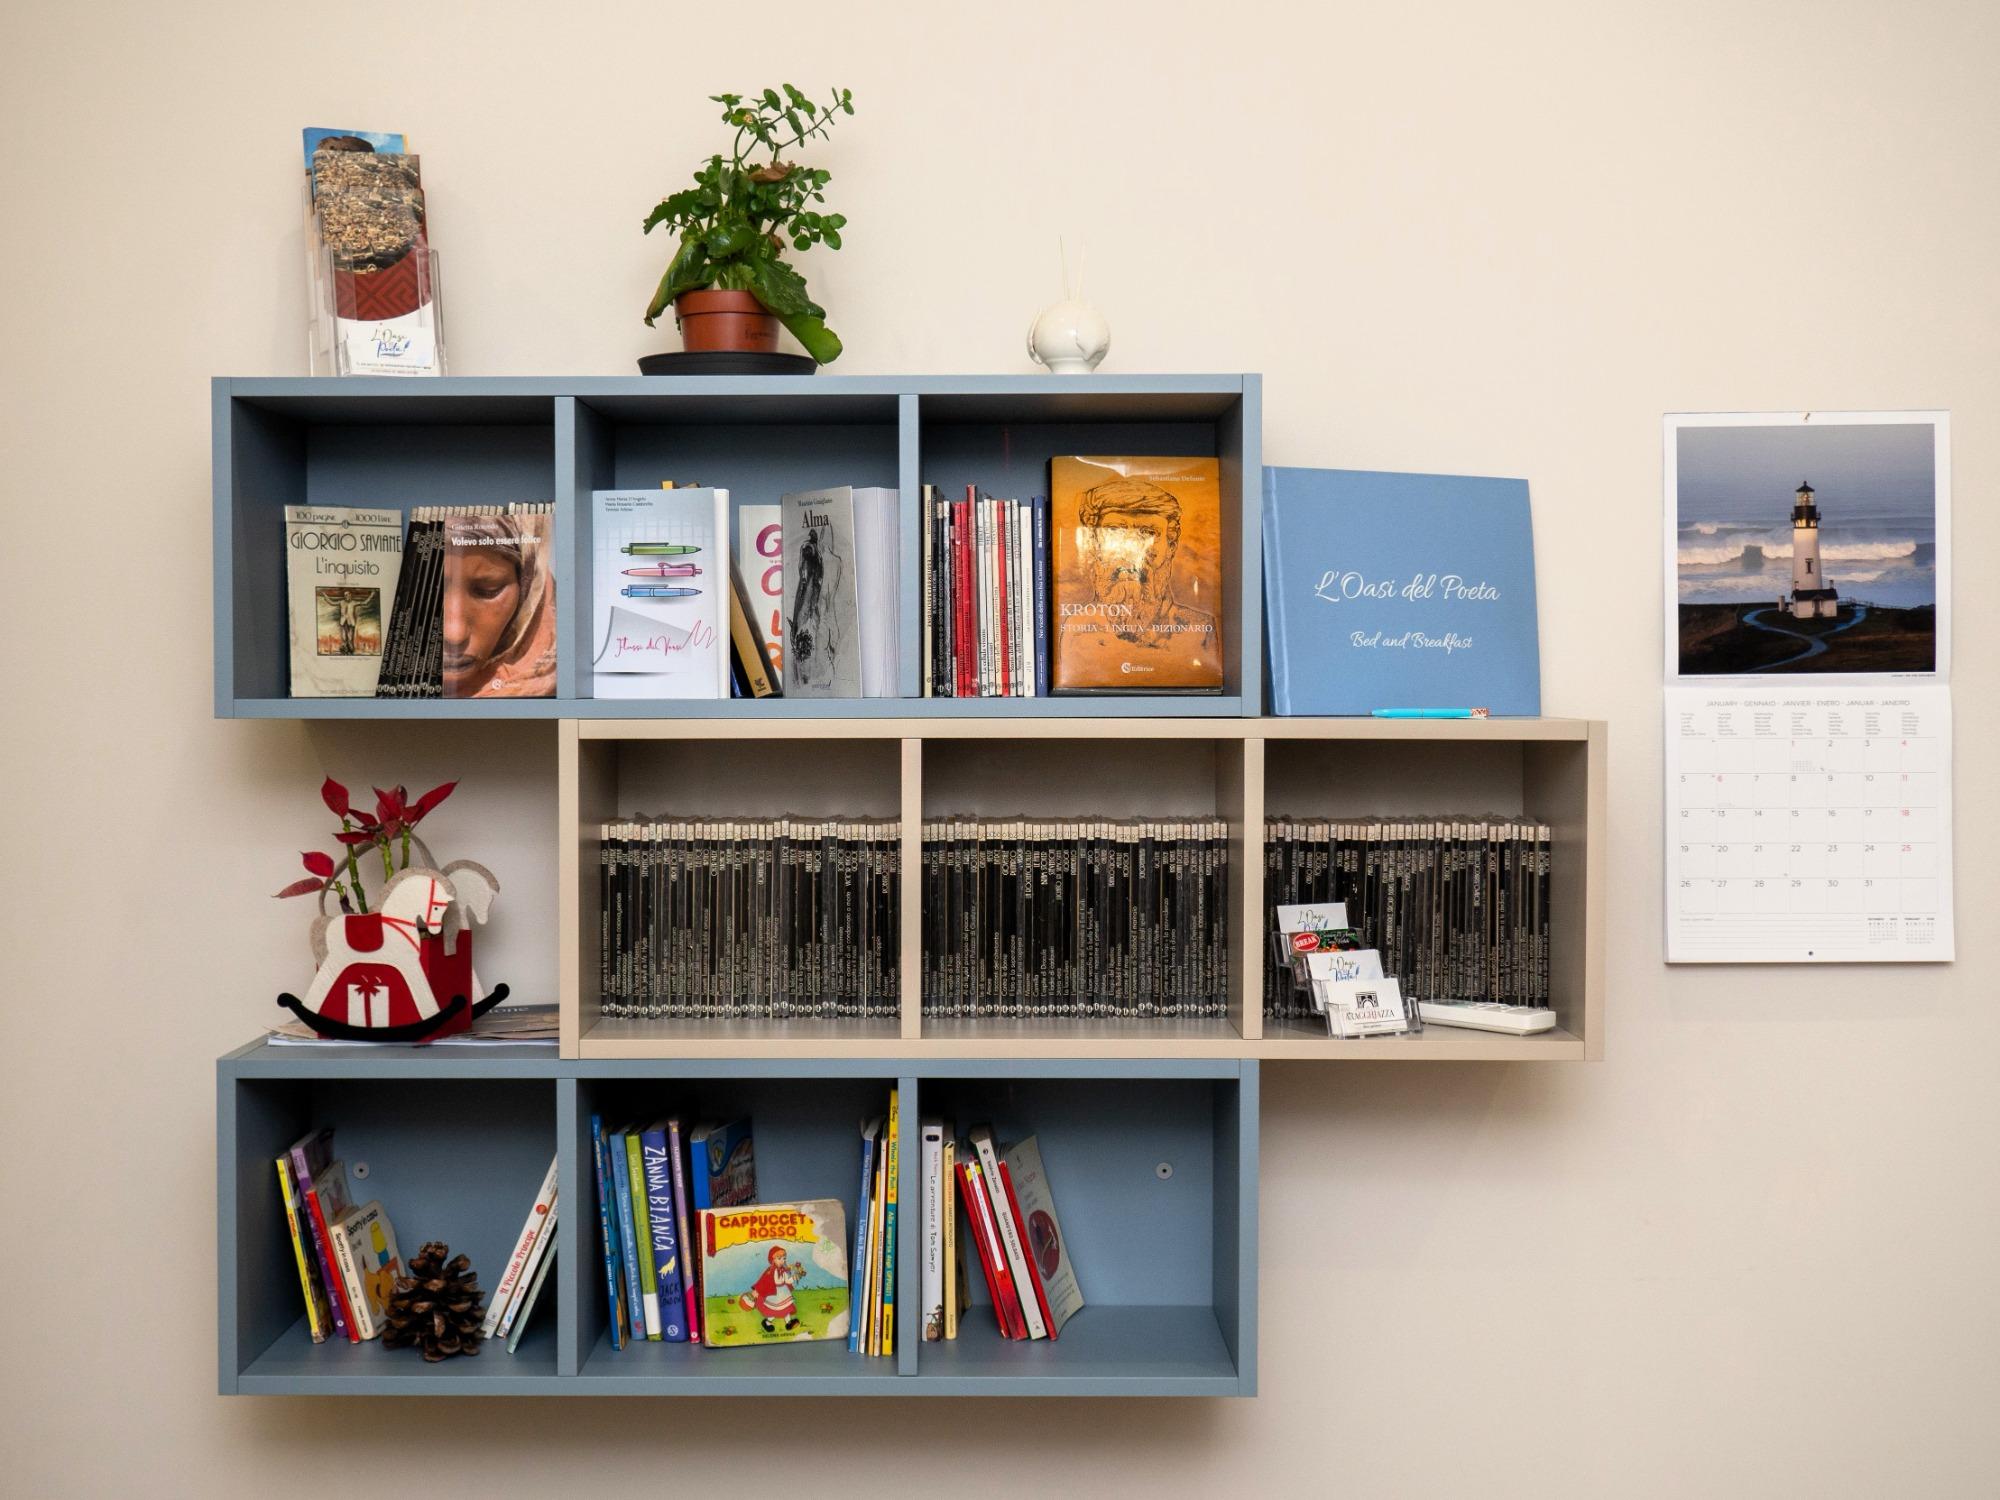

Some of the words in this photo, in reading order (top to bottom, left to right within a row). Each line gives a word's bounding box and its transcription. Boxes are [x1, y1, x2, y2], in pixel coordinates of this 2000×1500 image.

[801, 510, 829, 529] Alma
[290, 532, 357, 551] GIORGIO
[360, 534, 401, 553] SAVIANE
[451, 537, 478, 546] Volevo
[478, 536, 494, 546] solo
[495, 537, 519, 545] essere
[521, 533, 542, 545] felice
[316, 556, 380, 579] L'inquisito
[1314, 570, 1398, 602] L'Oasi
[1401, 573, 1434, 602] del
[1440, 574, 1501, 601] Poeta
[1060, 603, 1133, 617] KROTON
[1060, 624, 1098, 632] STORIA
[1105, 624, 1145, 632] LINGUA
[1152, 624, 1213, 632] DIZIONARIO
[1350, 631, 1378, 648] Bed
[1382, 632, 1411, 648] and
[1411, 632, 1473, 655] Breakfast
[1681, 810, 1689, 818] 12
[1827, 809, 1836, 817] 16
[1864, 809, 1872, 817] 17
[1901, 809, 1910, 817] 18
[1680, 845, 1689, 853] 19
[1717, 845, 1728, 853] 20
[1827, 844, 1838, 852] 23
[1864, 844, 1875, 852] 24
[1901, 844, 1912, 852] 25
[1680, 880, 1691, 888] 26
[1717, 880, 1728, 888] 27
[1754, 880, 1765, 888] 28
[1791, 880, 1801, 888] 29
[1827, 880, 1839, 888] 30
[889, 1141, 898, 1163] Winnie
[643, 1144, 671, 1193] ZANNA
[889, 1164, 897, 1175] the
[888, 1176, 897, 1191] Pooh
[929, 1175, 937, 1185] Le
[929, 1185, 937, 1223] avventure
[647, 1194, 676, 1252] BIANCA
[719, 1213, 814, 1228] CAPPUCCET
[886, 1210, 895, 1225] Alla
[749, 1226, 797, 1239] ROSSO
[929, 1232, 937, 1246] Tom
[334, 1232, 346, 1254] Spotty
[342, 1258, 352, 1274] casa
[513, 1229, 536, 1259] Principe
[1009, 1239, 1021, 1262] SOLDATO
[854, 1245, 865, 1271] Racconti
[884, 1252, 894, 1269] degli
[928, 1247, 937, 1273] Sawyer
[503, 1256, 522, 1286] Piccolo
[499, 1284, 509, 1295] Il
